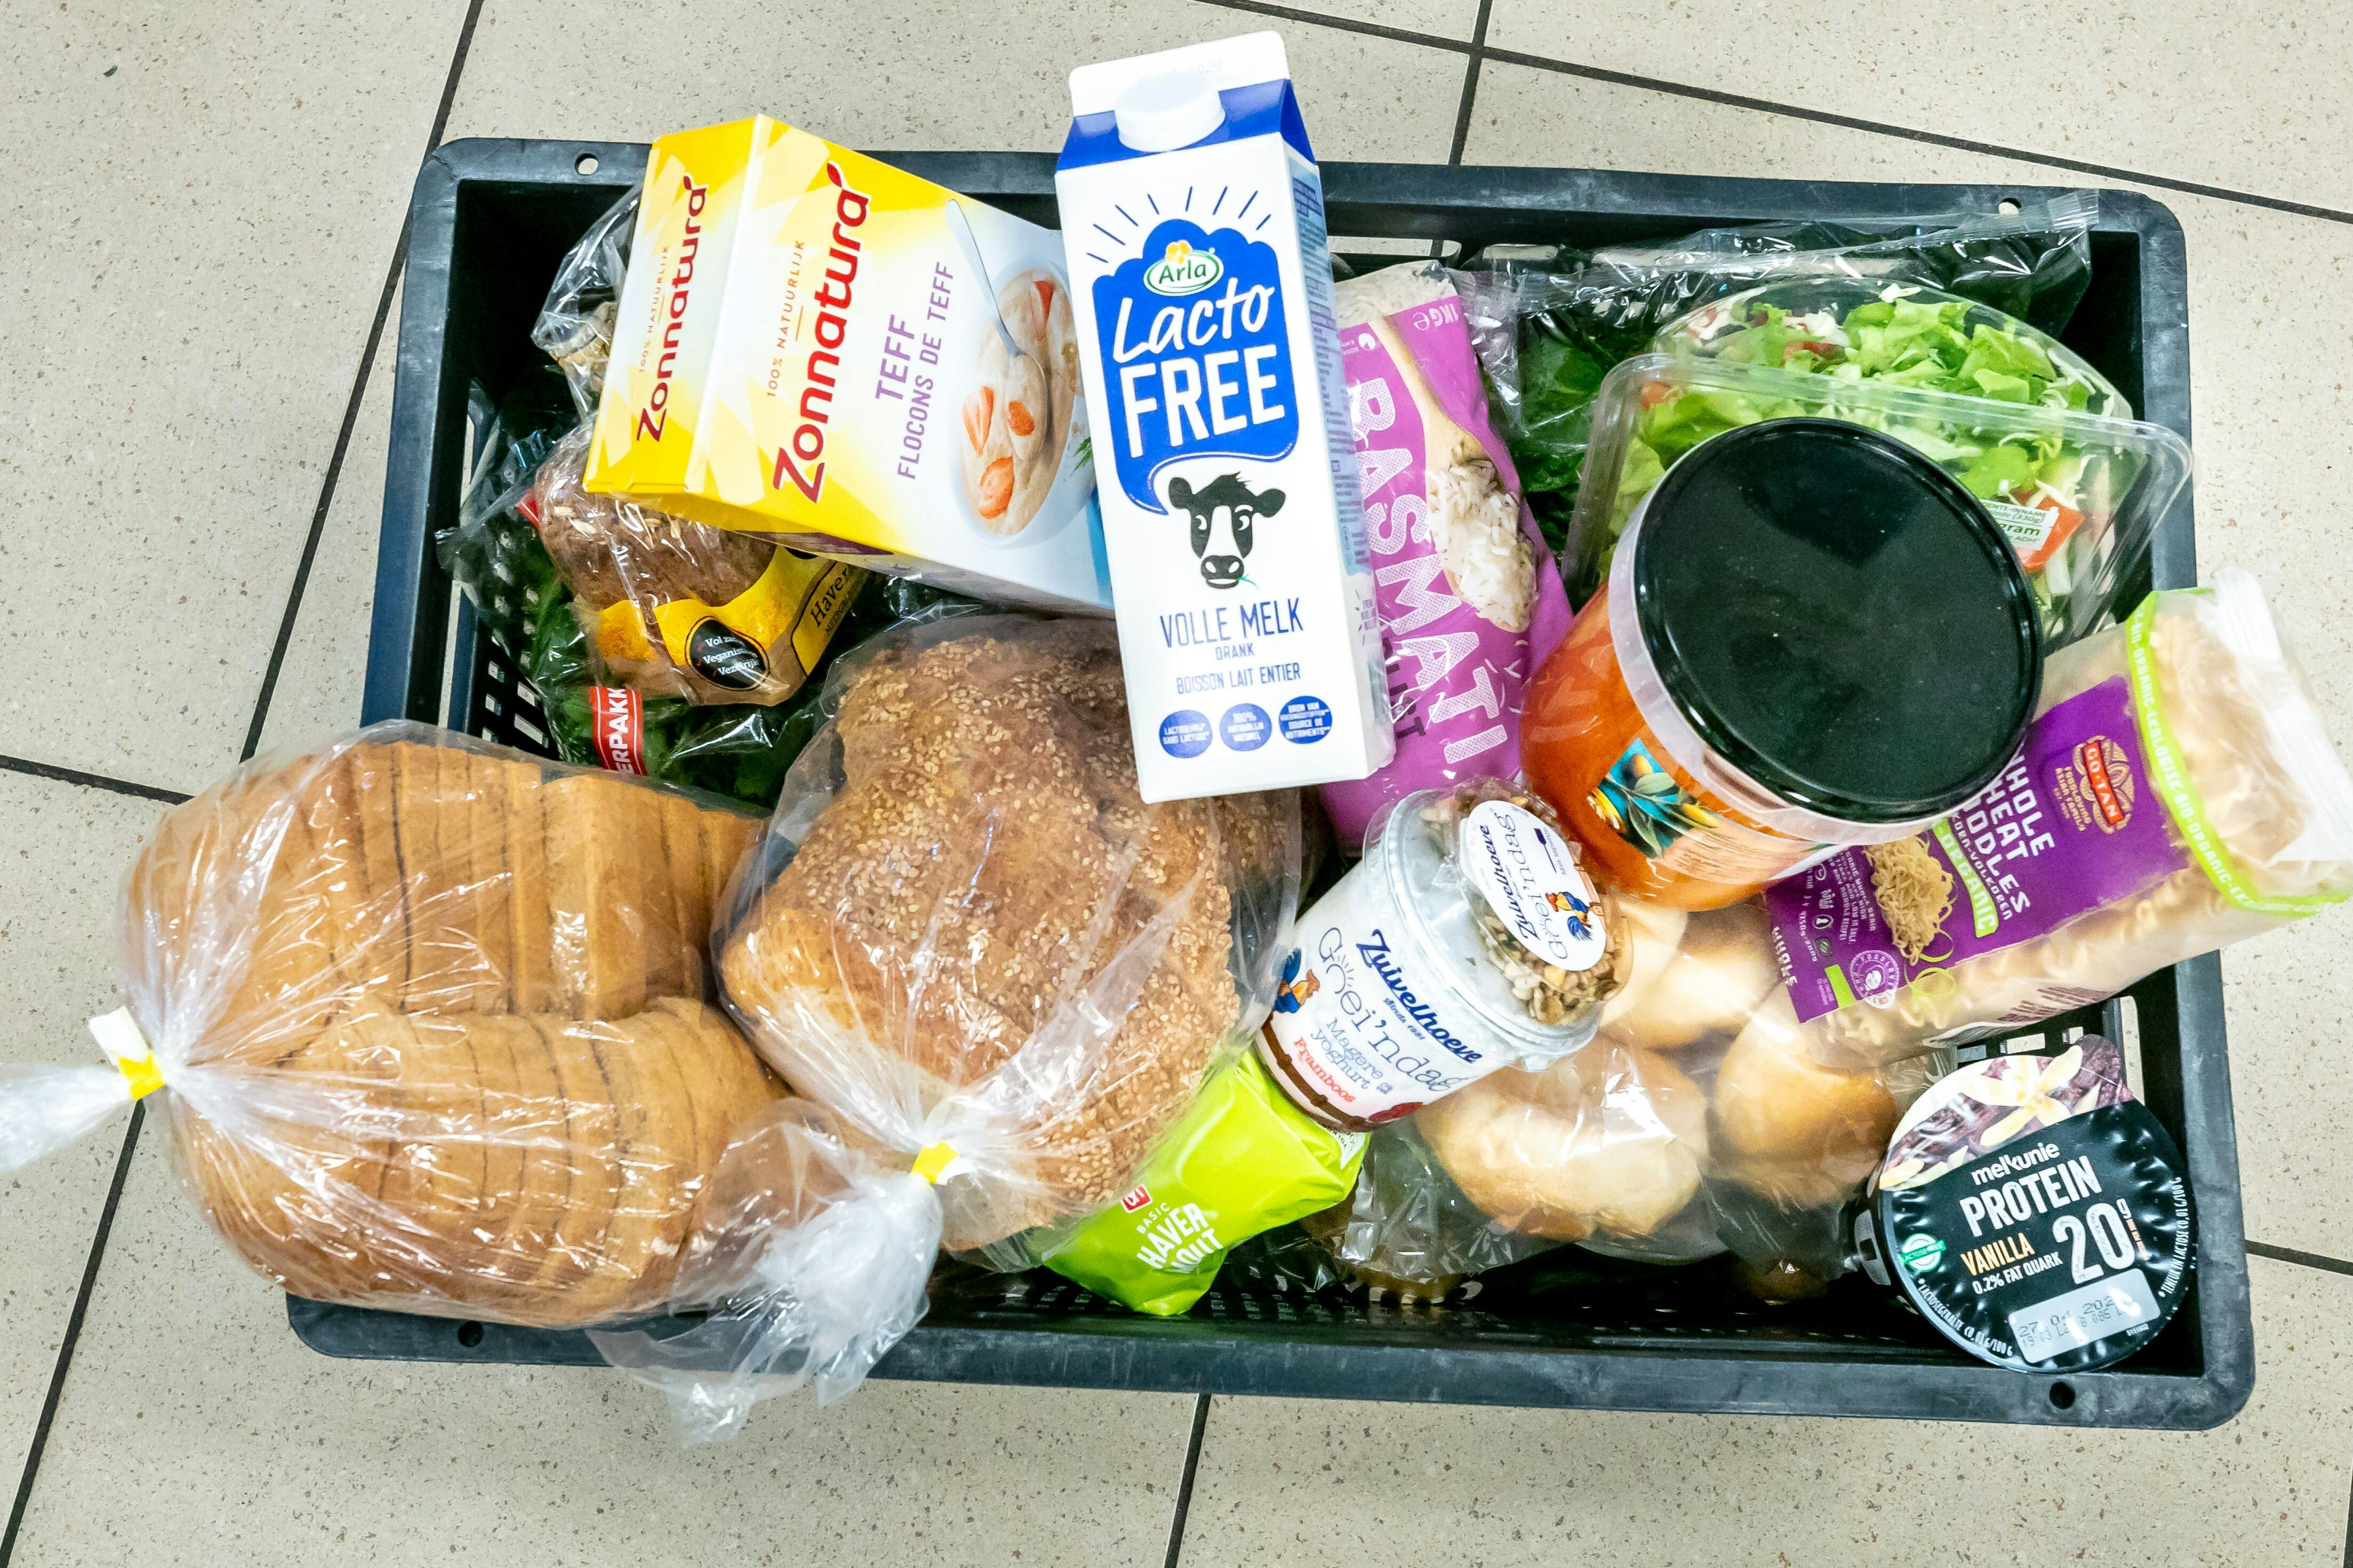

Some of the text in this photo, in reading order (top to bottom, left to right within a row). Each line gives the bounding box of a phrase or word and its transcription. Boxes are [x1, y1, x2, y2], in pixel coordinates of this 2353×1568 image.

[1158, 258, 1207, 284] Arla
[636, 173, 708, 443] Zonnatura
[639, 245, 669, 373] 100% NATUURLIJK
[767, 239, 805, 397] 100% NATUURLIJK
[773, 161, 873, 504] Zonnatura
[1113, 278, 1275, 363] Lacto
[1430, 302, 1459, 327] 1KG
[875, 314, 916, 401] TEFF
[898, 262, 955, 480] FLOCONS DE TEFF
[1119, 344, 1285, 459] FREE
[810, 567, 848, 628] Haver
[1160, 597, 1304, 649] VOLLE MELK
[704, 636, 724, 647] Vol
[1215, 642, 1255, 661] DRANK
[1176, 663, 1301, 694] BOISSON LAIT ENTIER
[1962, 798, 2031, 913] ODLES
[1986, 784, 2029, 861] HEAT
[1479, 825, 1541, 941] Zuivelhoeve
[1356, 929, 1483, 1064] Zuivelhoeve
[1293, 1036, 1356, 1104] Framboos
[1311, 1028, 1371, 1089] yoghurt
[1326, 1017, 1383, 1080] Magere
[1959, 1155, 2103, 1237] PROTEIN
[1971, 1141, 2061, 1186] melkunie
[1136, 1202, 1171, 1235] BASIC
[1136, 1202, 1208, 1269] HAVER
[2052, 1202, 2136, 1285] 20
[2172, 1229, 2189, 1260] LACTOSE
[1959, 1232, 2035, 1276] VANILLA
[1972, 1251, 2063, 1296] 0.2% FAT QUARK
[2018, 1321, 2038, 1338] 27
